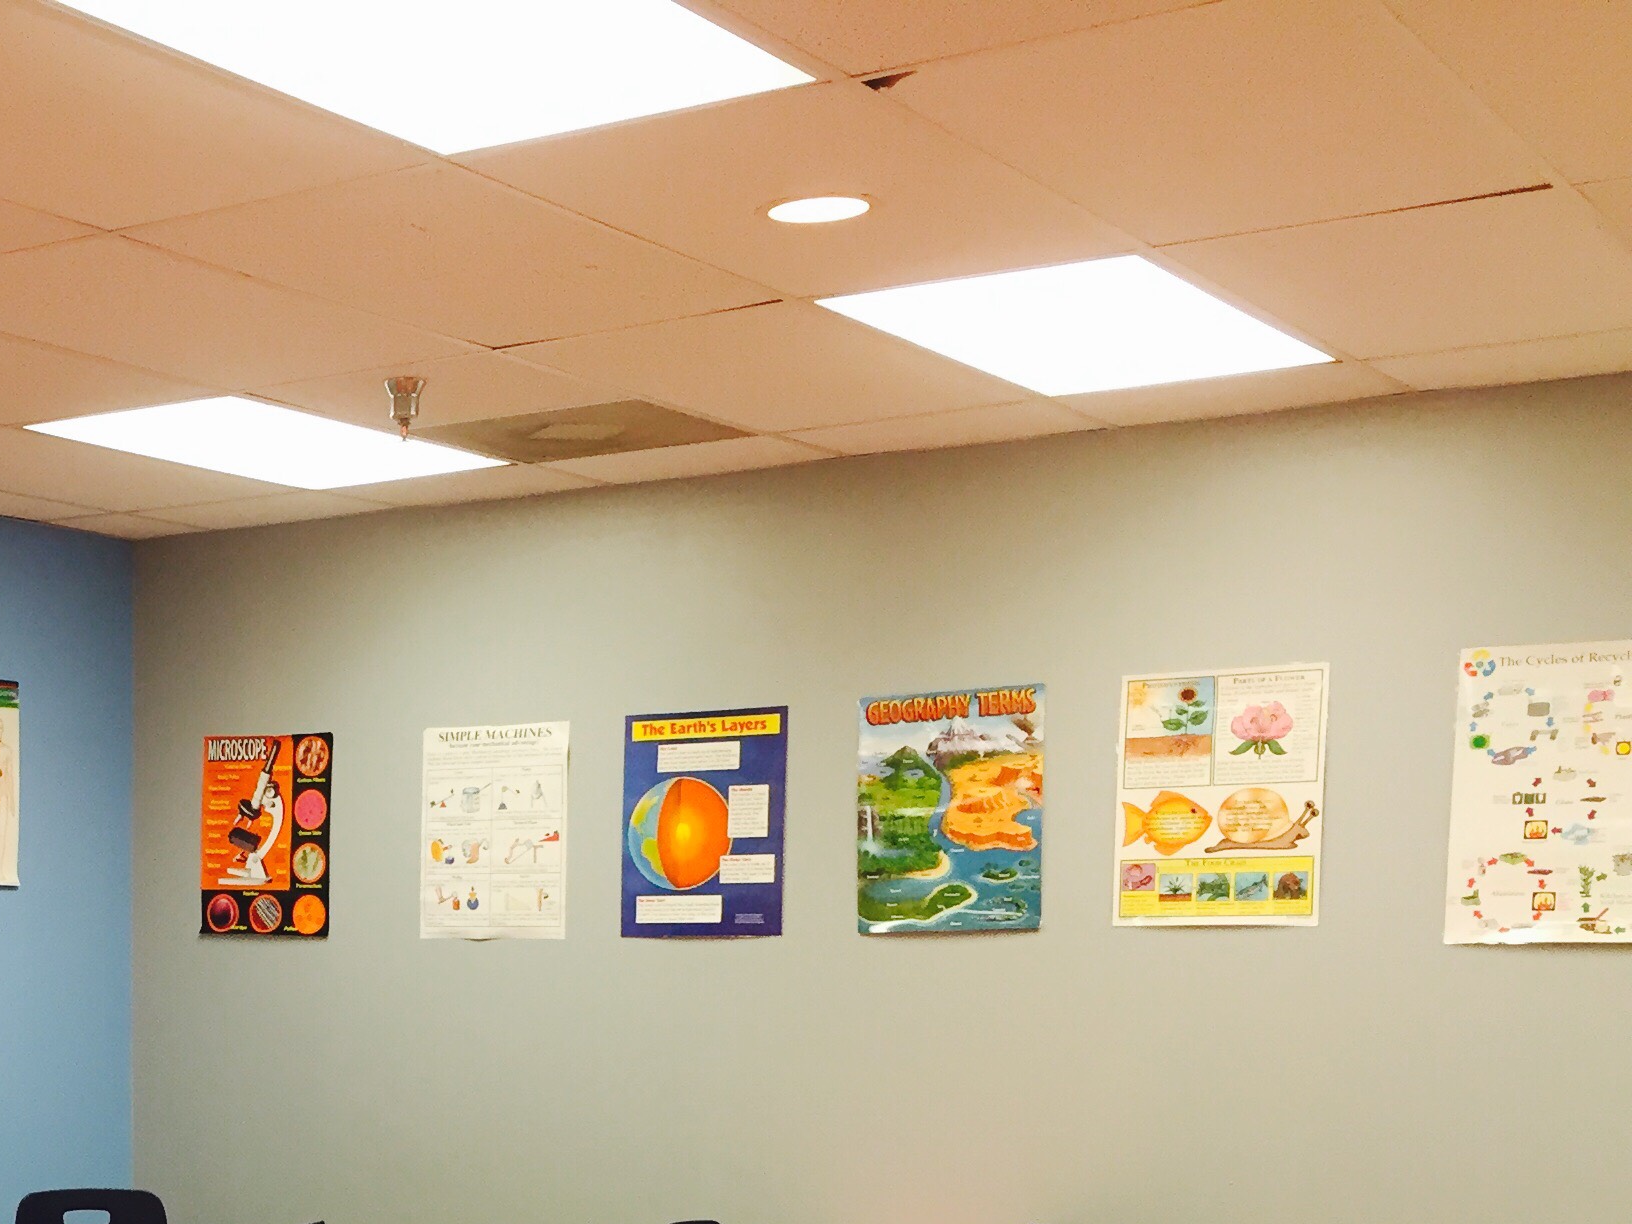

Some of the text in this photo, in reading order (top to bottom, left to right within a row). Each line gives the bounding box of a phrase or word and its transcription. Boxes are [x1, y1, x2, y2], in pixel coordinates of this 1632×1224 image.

[1499, 656, 1521, 667] The
[1525, 654, 1568, 666] Cycles
[1571, 653, 1584, 664] of
[866, 688, 1037, 726] GEOGRAPHY TERMS
[438, 727, 553, 742] SIMPLE MACHINES
[641, 719, 767, 737] The Earth's Layers
[208, 738, 267, 761] MICROSCOPE
